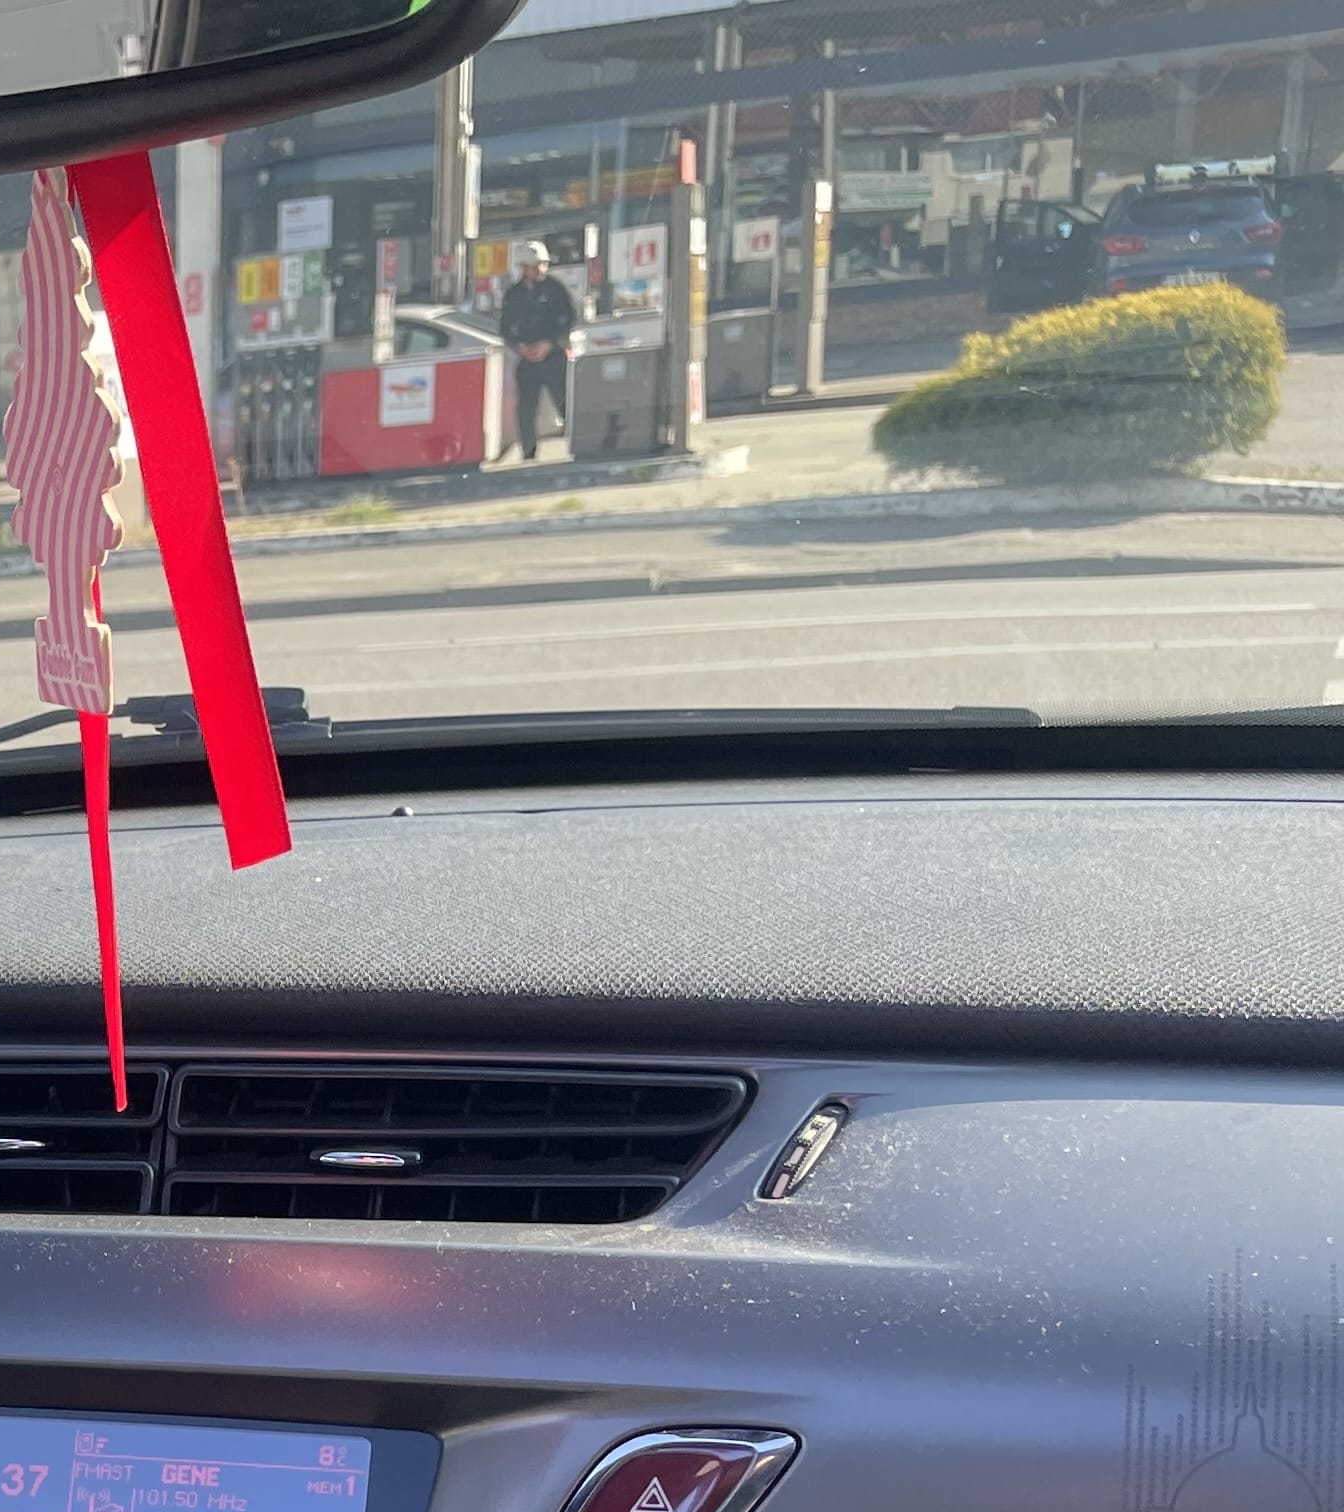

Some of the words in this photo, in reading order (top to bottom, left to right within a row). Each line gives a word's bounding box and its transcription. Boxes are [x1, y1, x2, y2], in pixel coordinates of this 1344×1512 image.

[319, 1446, 335, 1466] 8
[0, 1463, 50, 1497] 37
[161, 1463, 221, 1488] GENE
[207, 1493, 249, 1512] MHz
